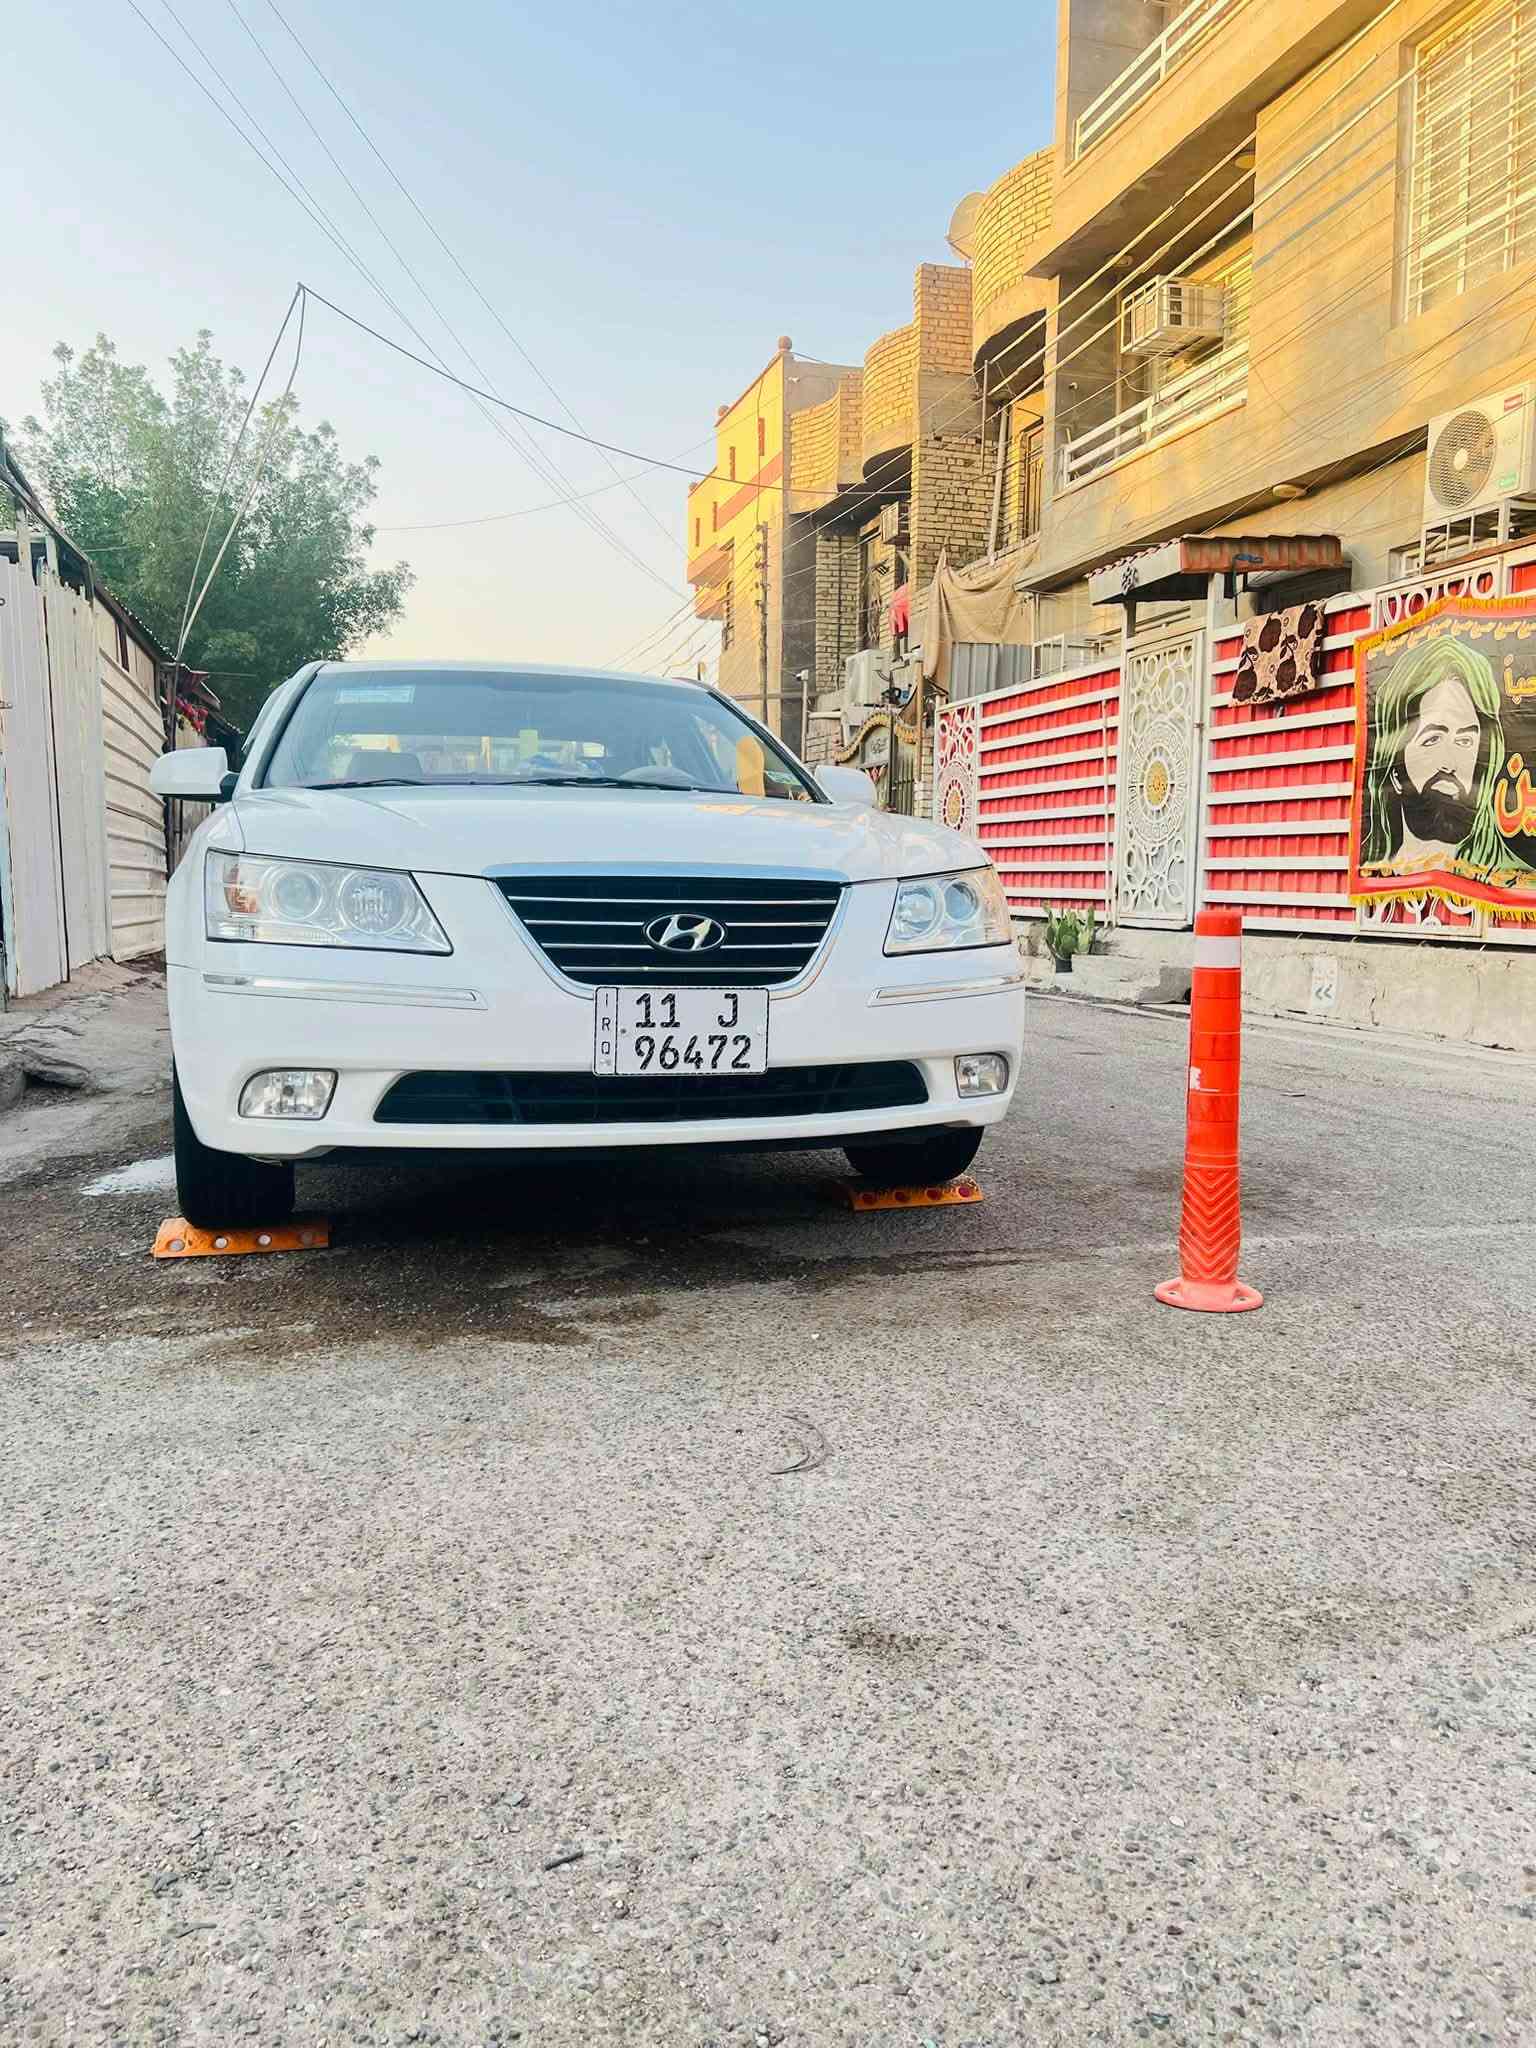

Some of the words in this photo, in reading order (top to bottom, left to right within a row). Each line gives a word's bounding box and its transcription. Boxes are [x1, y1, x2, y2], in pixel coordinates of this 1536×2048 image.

[635, 992, 681, 1028] 11
[717, 993, 739, 1028] J
[634, 1034, 751, 1070] 96472
